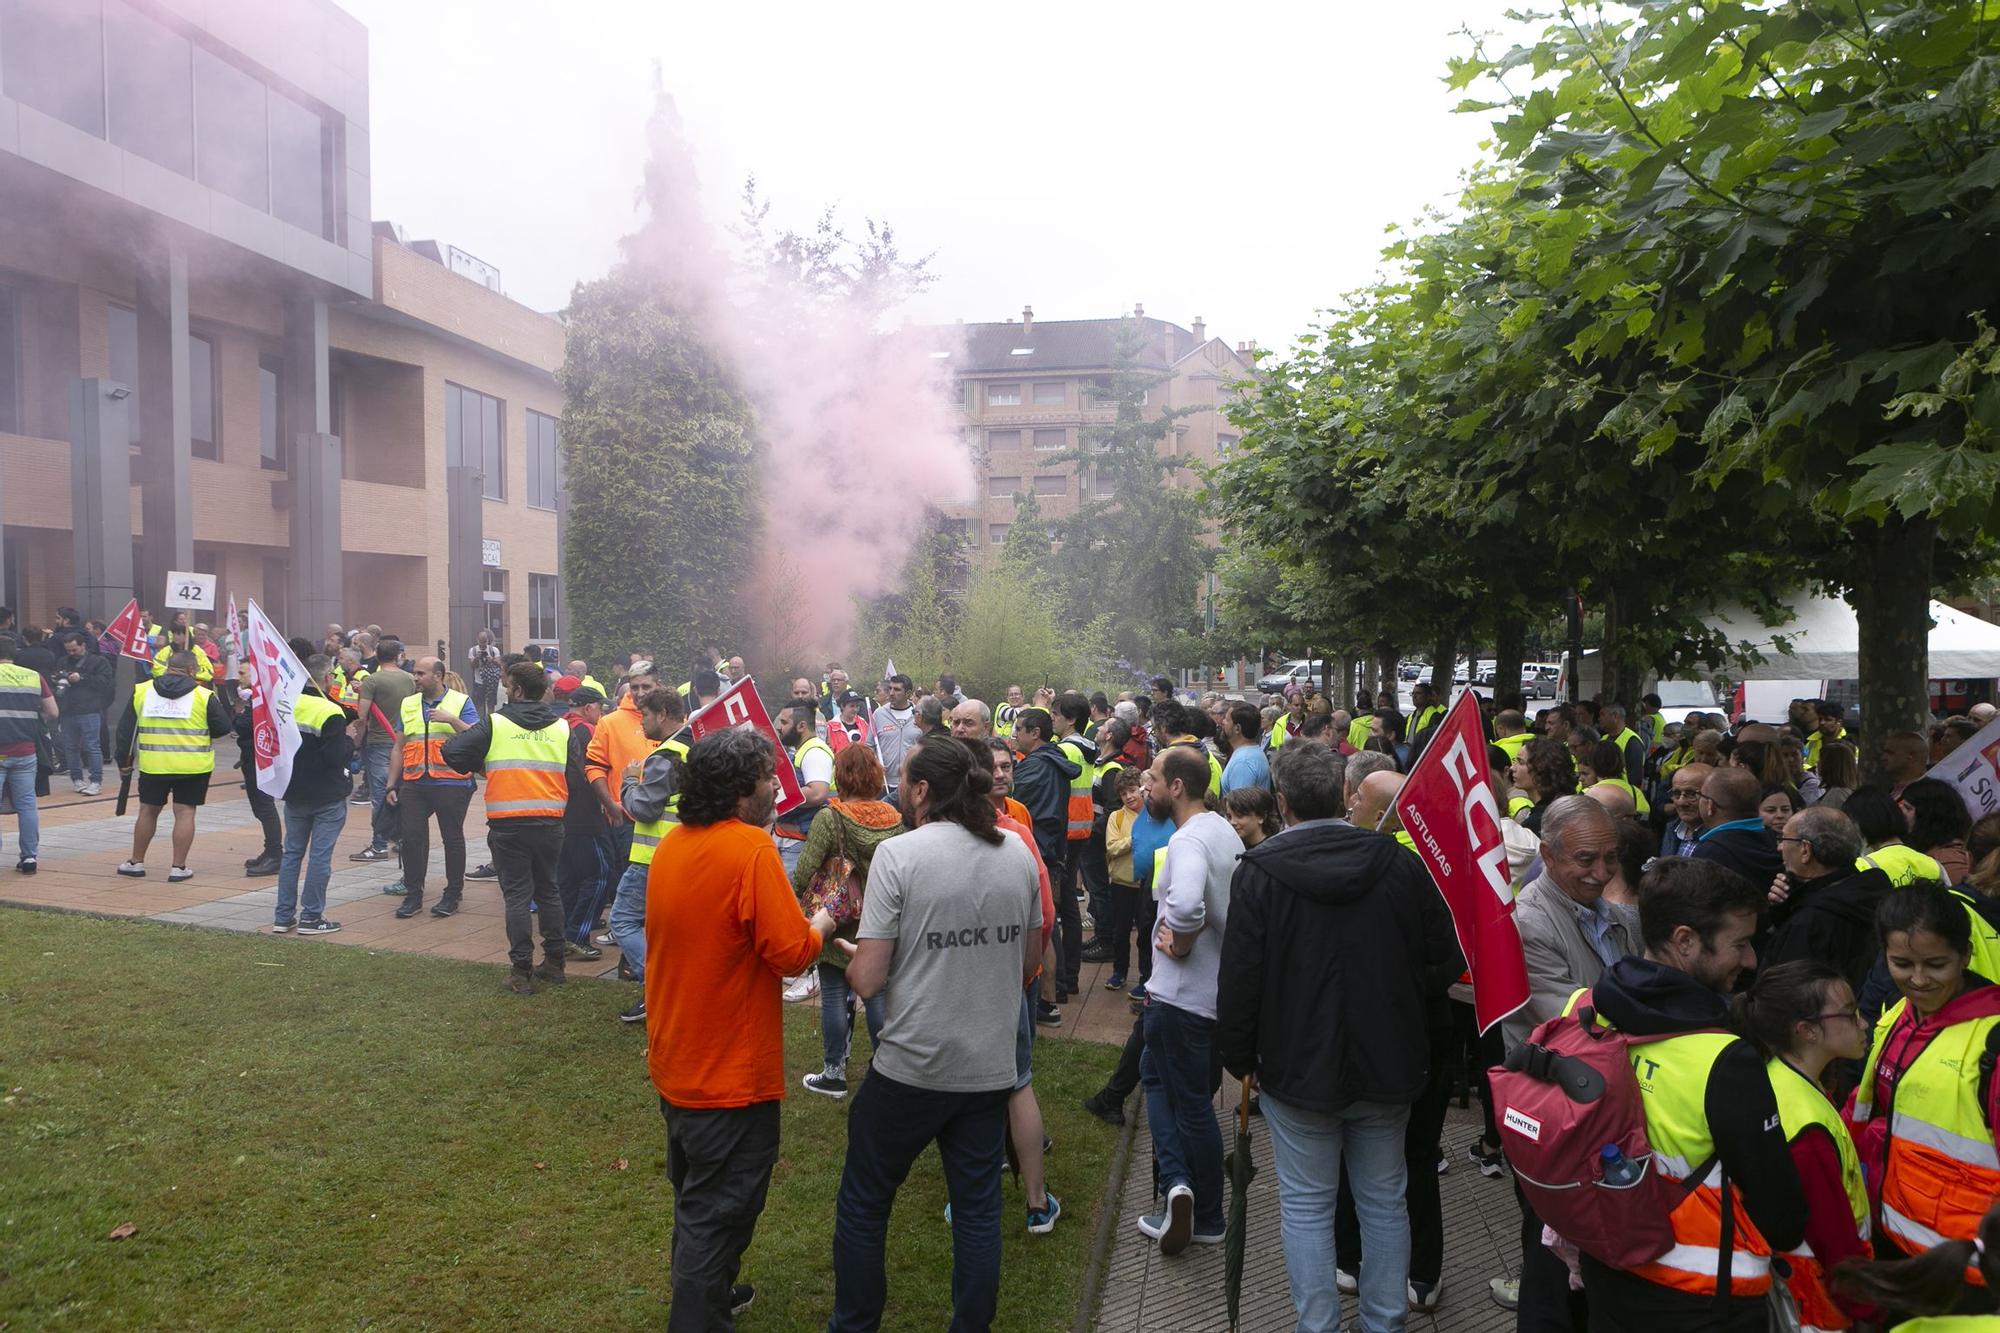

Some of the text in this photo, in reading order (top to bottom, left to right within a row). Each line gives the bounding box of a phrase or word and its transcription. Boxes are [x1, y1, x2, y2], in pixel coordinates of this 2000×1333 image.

[178, 585, 202, 601] 42
[1407, 803, 1452, 877] ASTURIAS
[926, 924, 1020, 950] RACK UP
[1506, 1113, 1538, 1135] HUNTER
